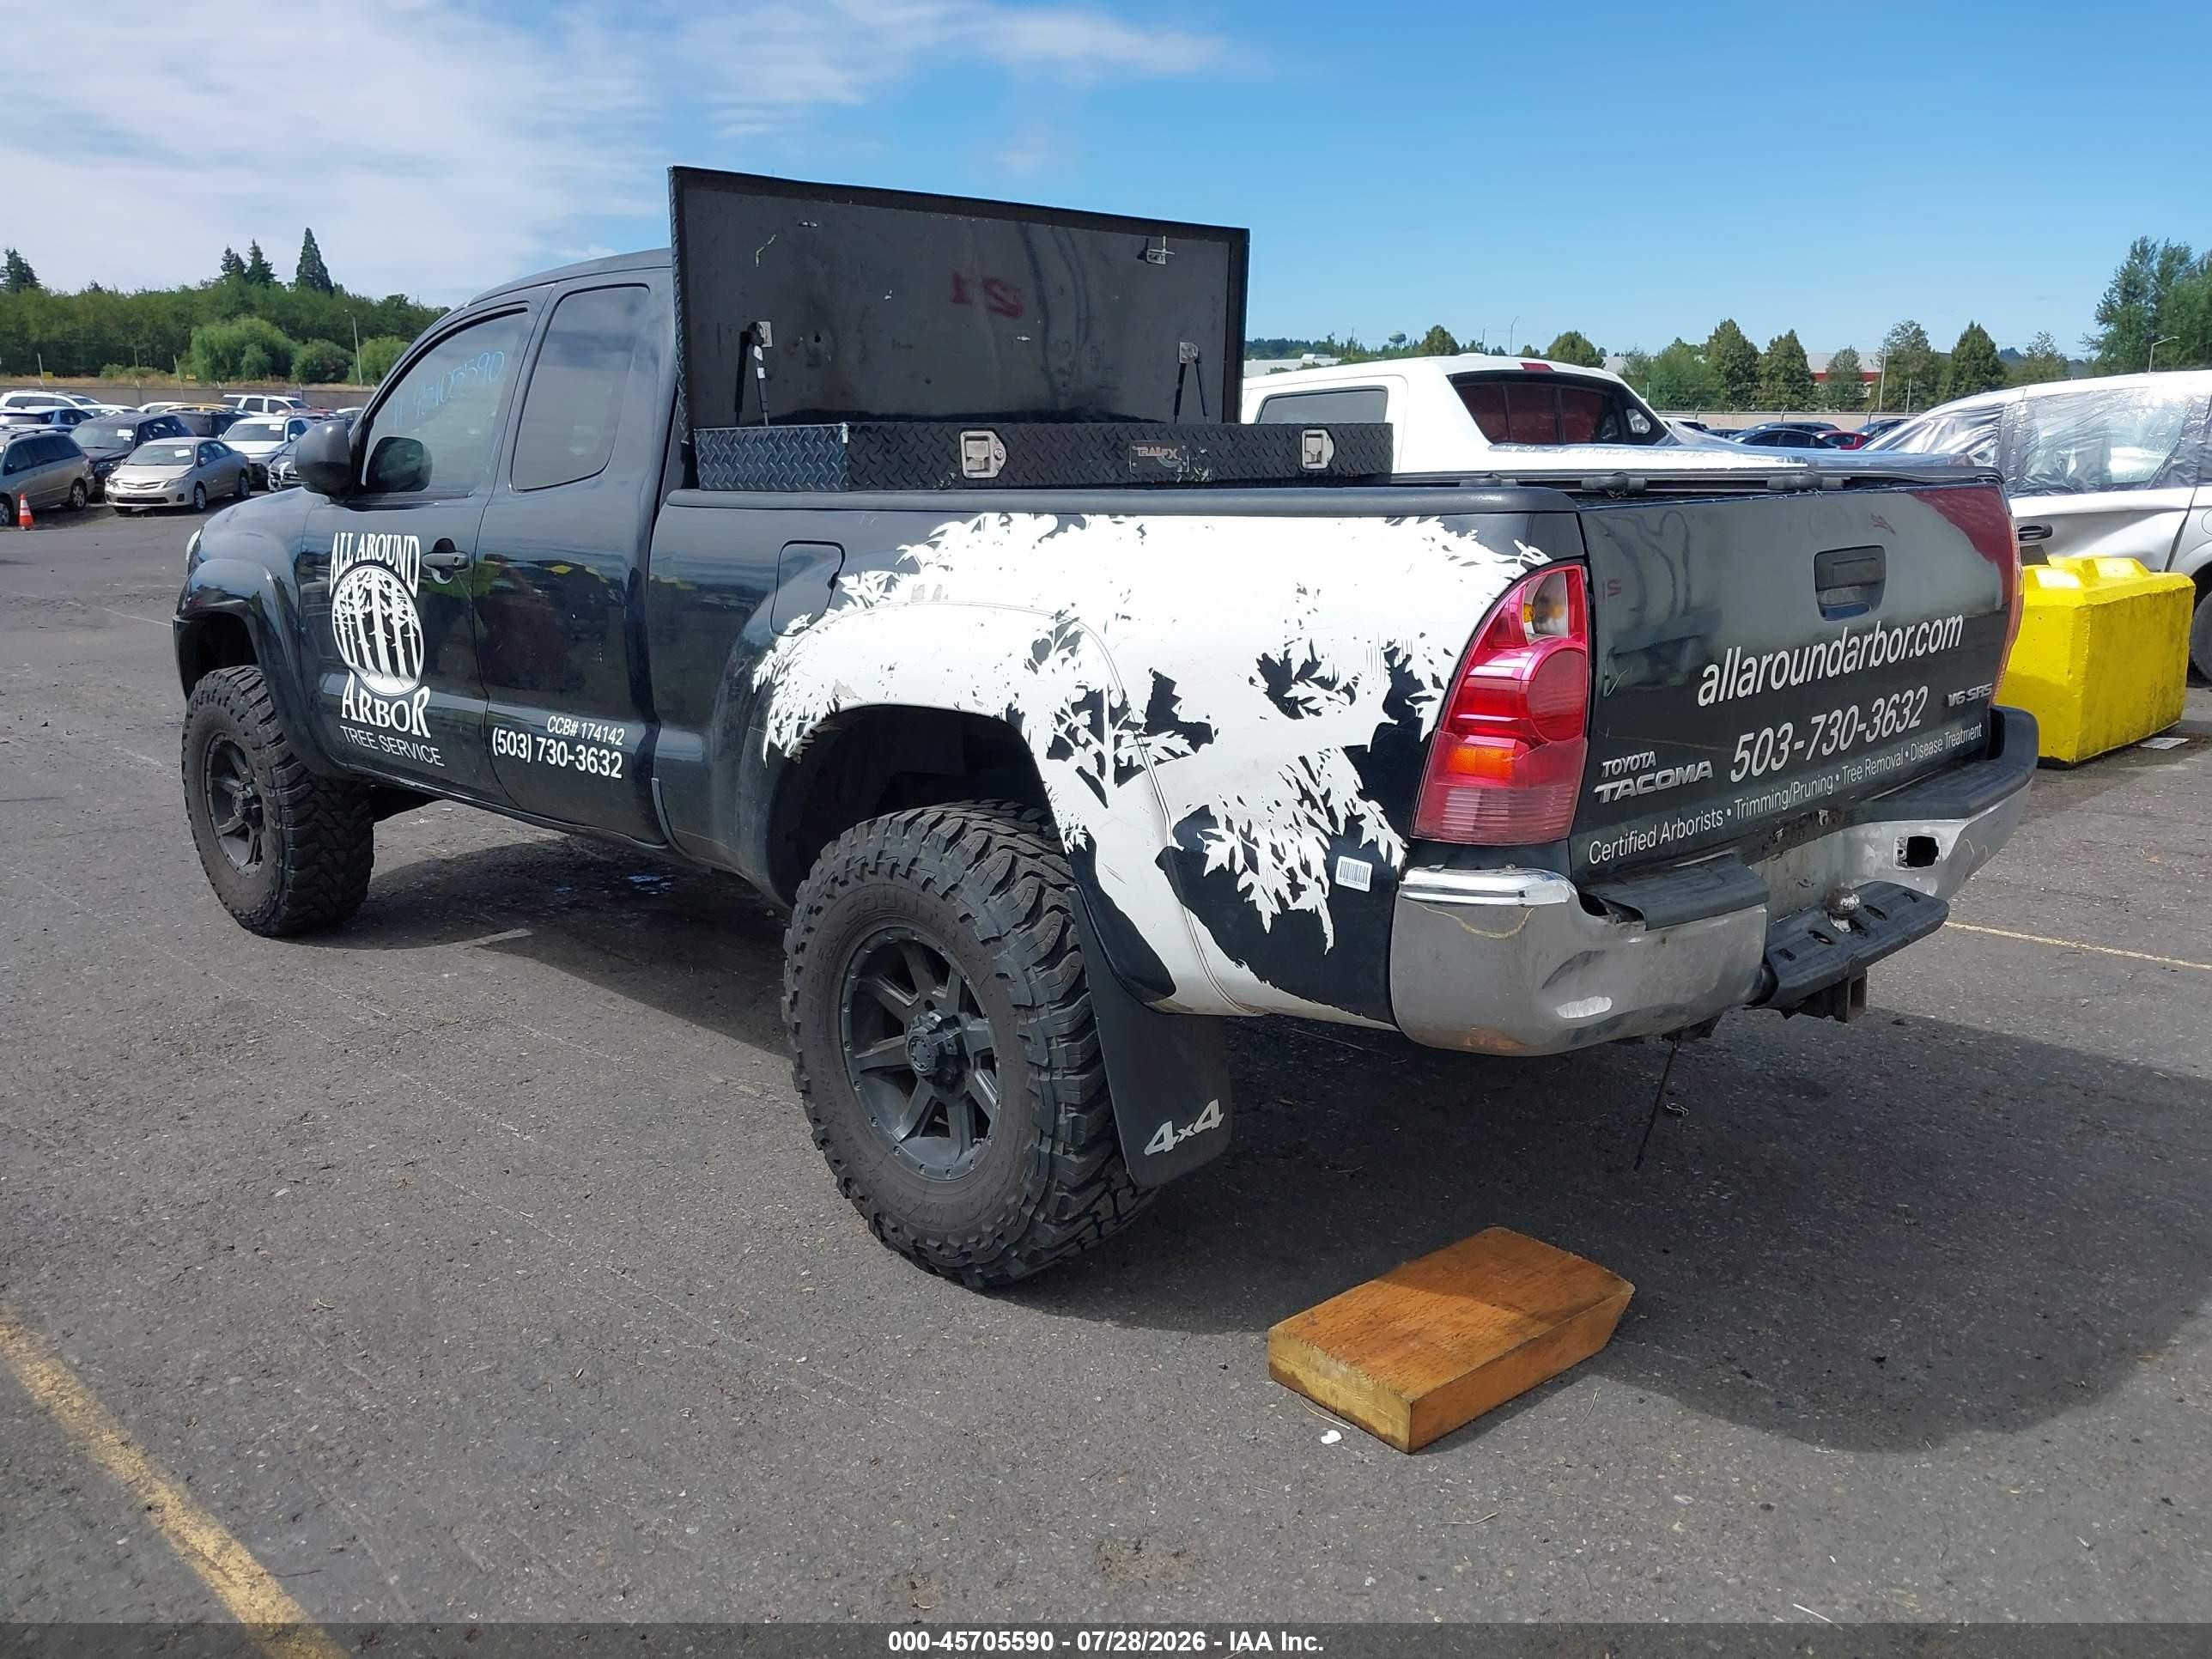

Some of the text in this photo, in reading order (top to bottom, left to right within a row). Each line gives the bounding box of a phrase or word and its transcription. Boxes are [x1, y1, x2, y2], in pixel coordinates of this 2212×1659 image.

[329, 532, 421, 599] ALL AROUND
[1697, 614, 1964, 707] allaroundarbor.com
[341, 670, 431, 738] ARBOR
[547, 715, 625, 746] CCB# 174142
[339, 725, 445, 767] TREE SERVICE
[492, 727, 623, 779] (503) 730-3632
[1601, 750, 1657, 777] TOYOTA
[1730, 685, 1929, 783] 503-730-3632
[1589, 722, 1983, 866] Certified Arborists Trimming/Pruning Tree Removal Disease Treatment
[1593, 760, 1714, 804] TACOMA
[1144, 1098, 1224, 1157] 4x4
